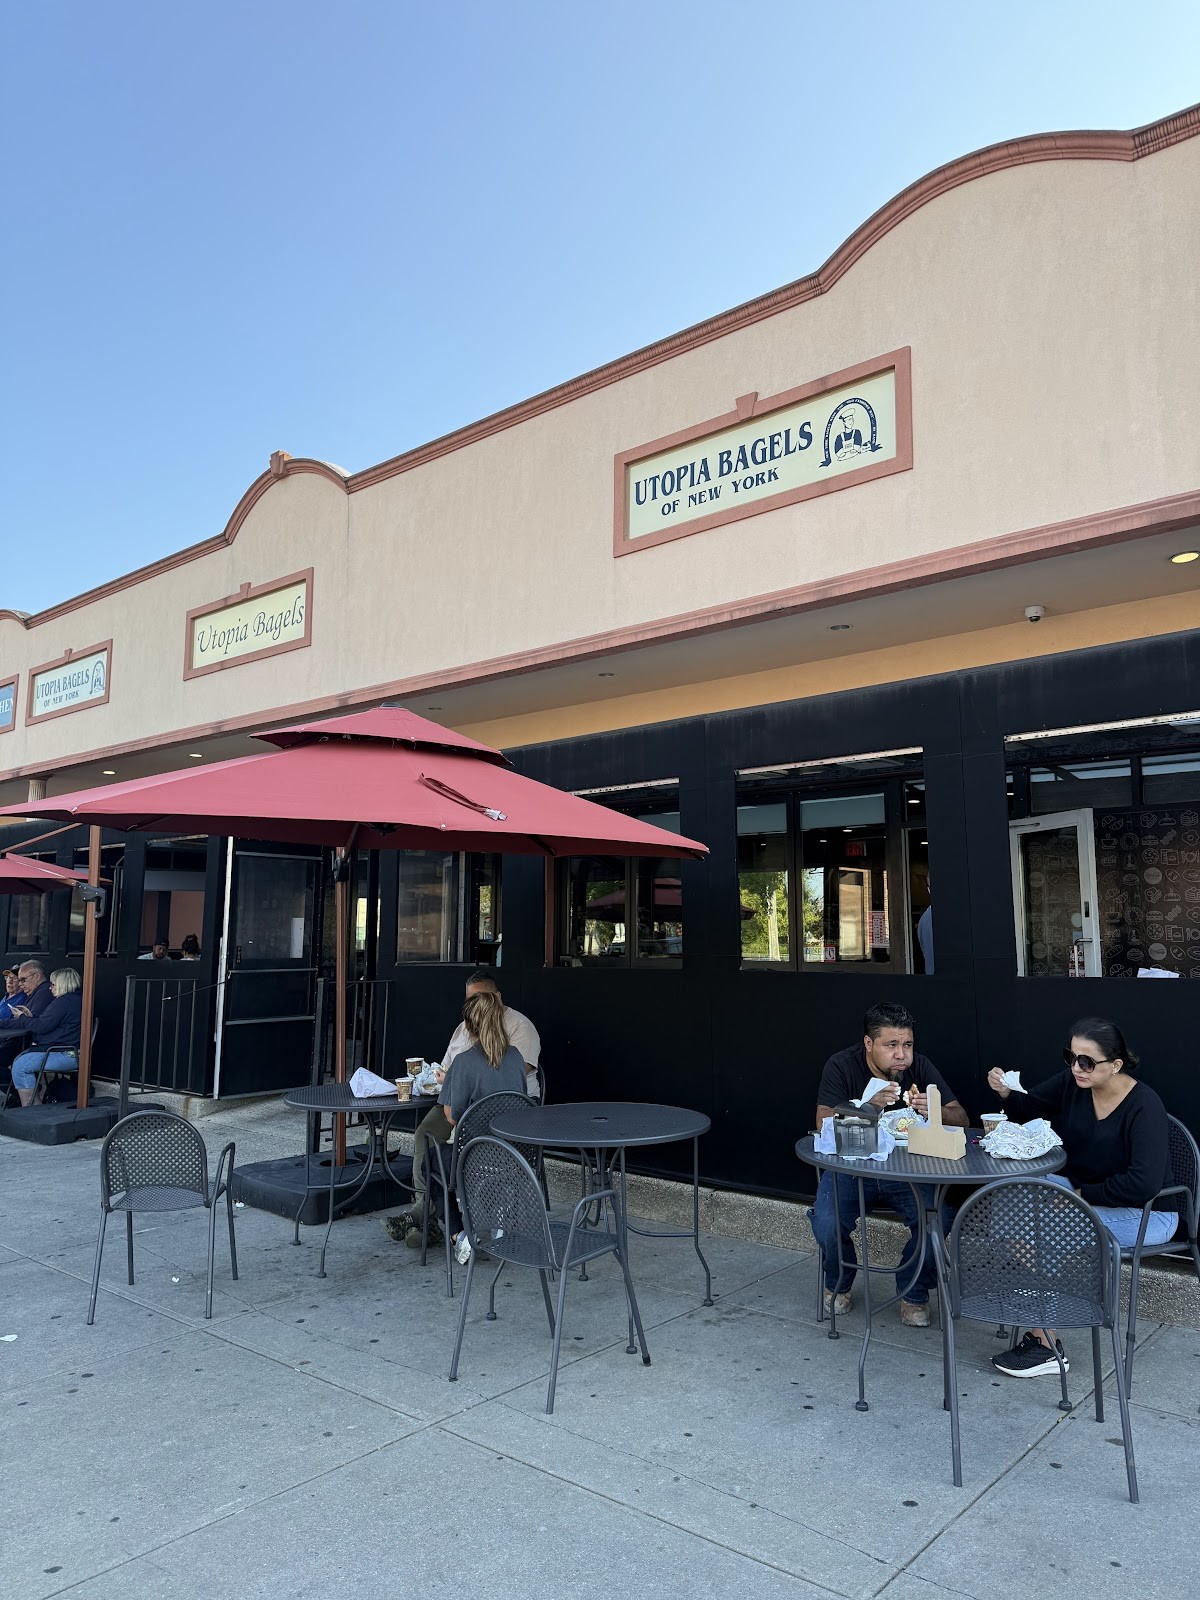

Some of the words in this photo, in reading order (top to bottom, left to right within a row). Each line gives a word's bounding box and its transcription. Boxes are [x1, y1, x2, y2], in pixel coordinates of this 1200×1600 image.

[634, 457, 711, 506] UTOPIA
[717, 421, 813, 479] BAGELS
[661, 499, 680, 516] OF
[688, 485, 722, 508] NEW
[731, 467, 780, 493] YORK
[197, 617, 248, 655] Utopia
[253, 595, 305, 640] Bagels
[37, 679, 60, 699] UTOPIA
[62, 669, 89, 690] BAGELS
